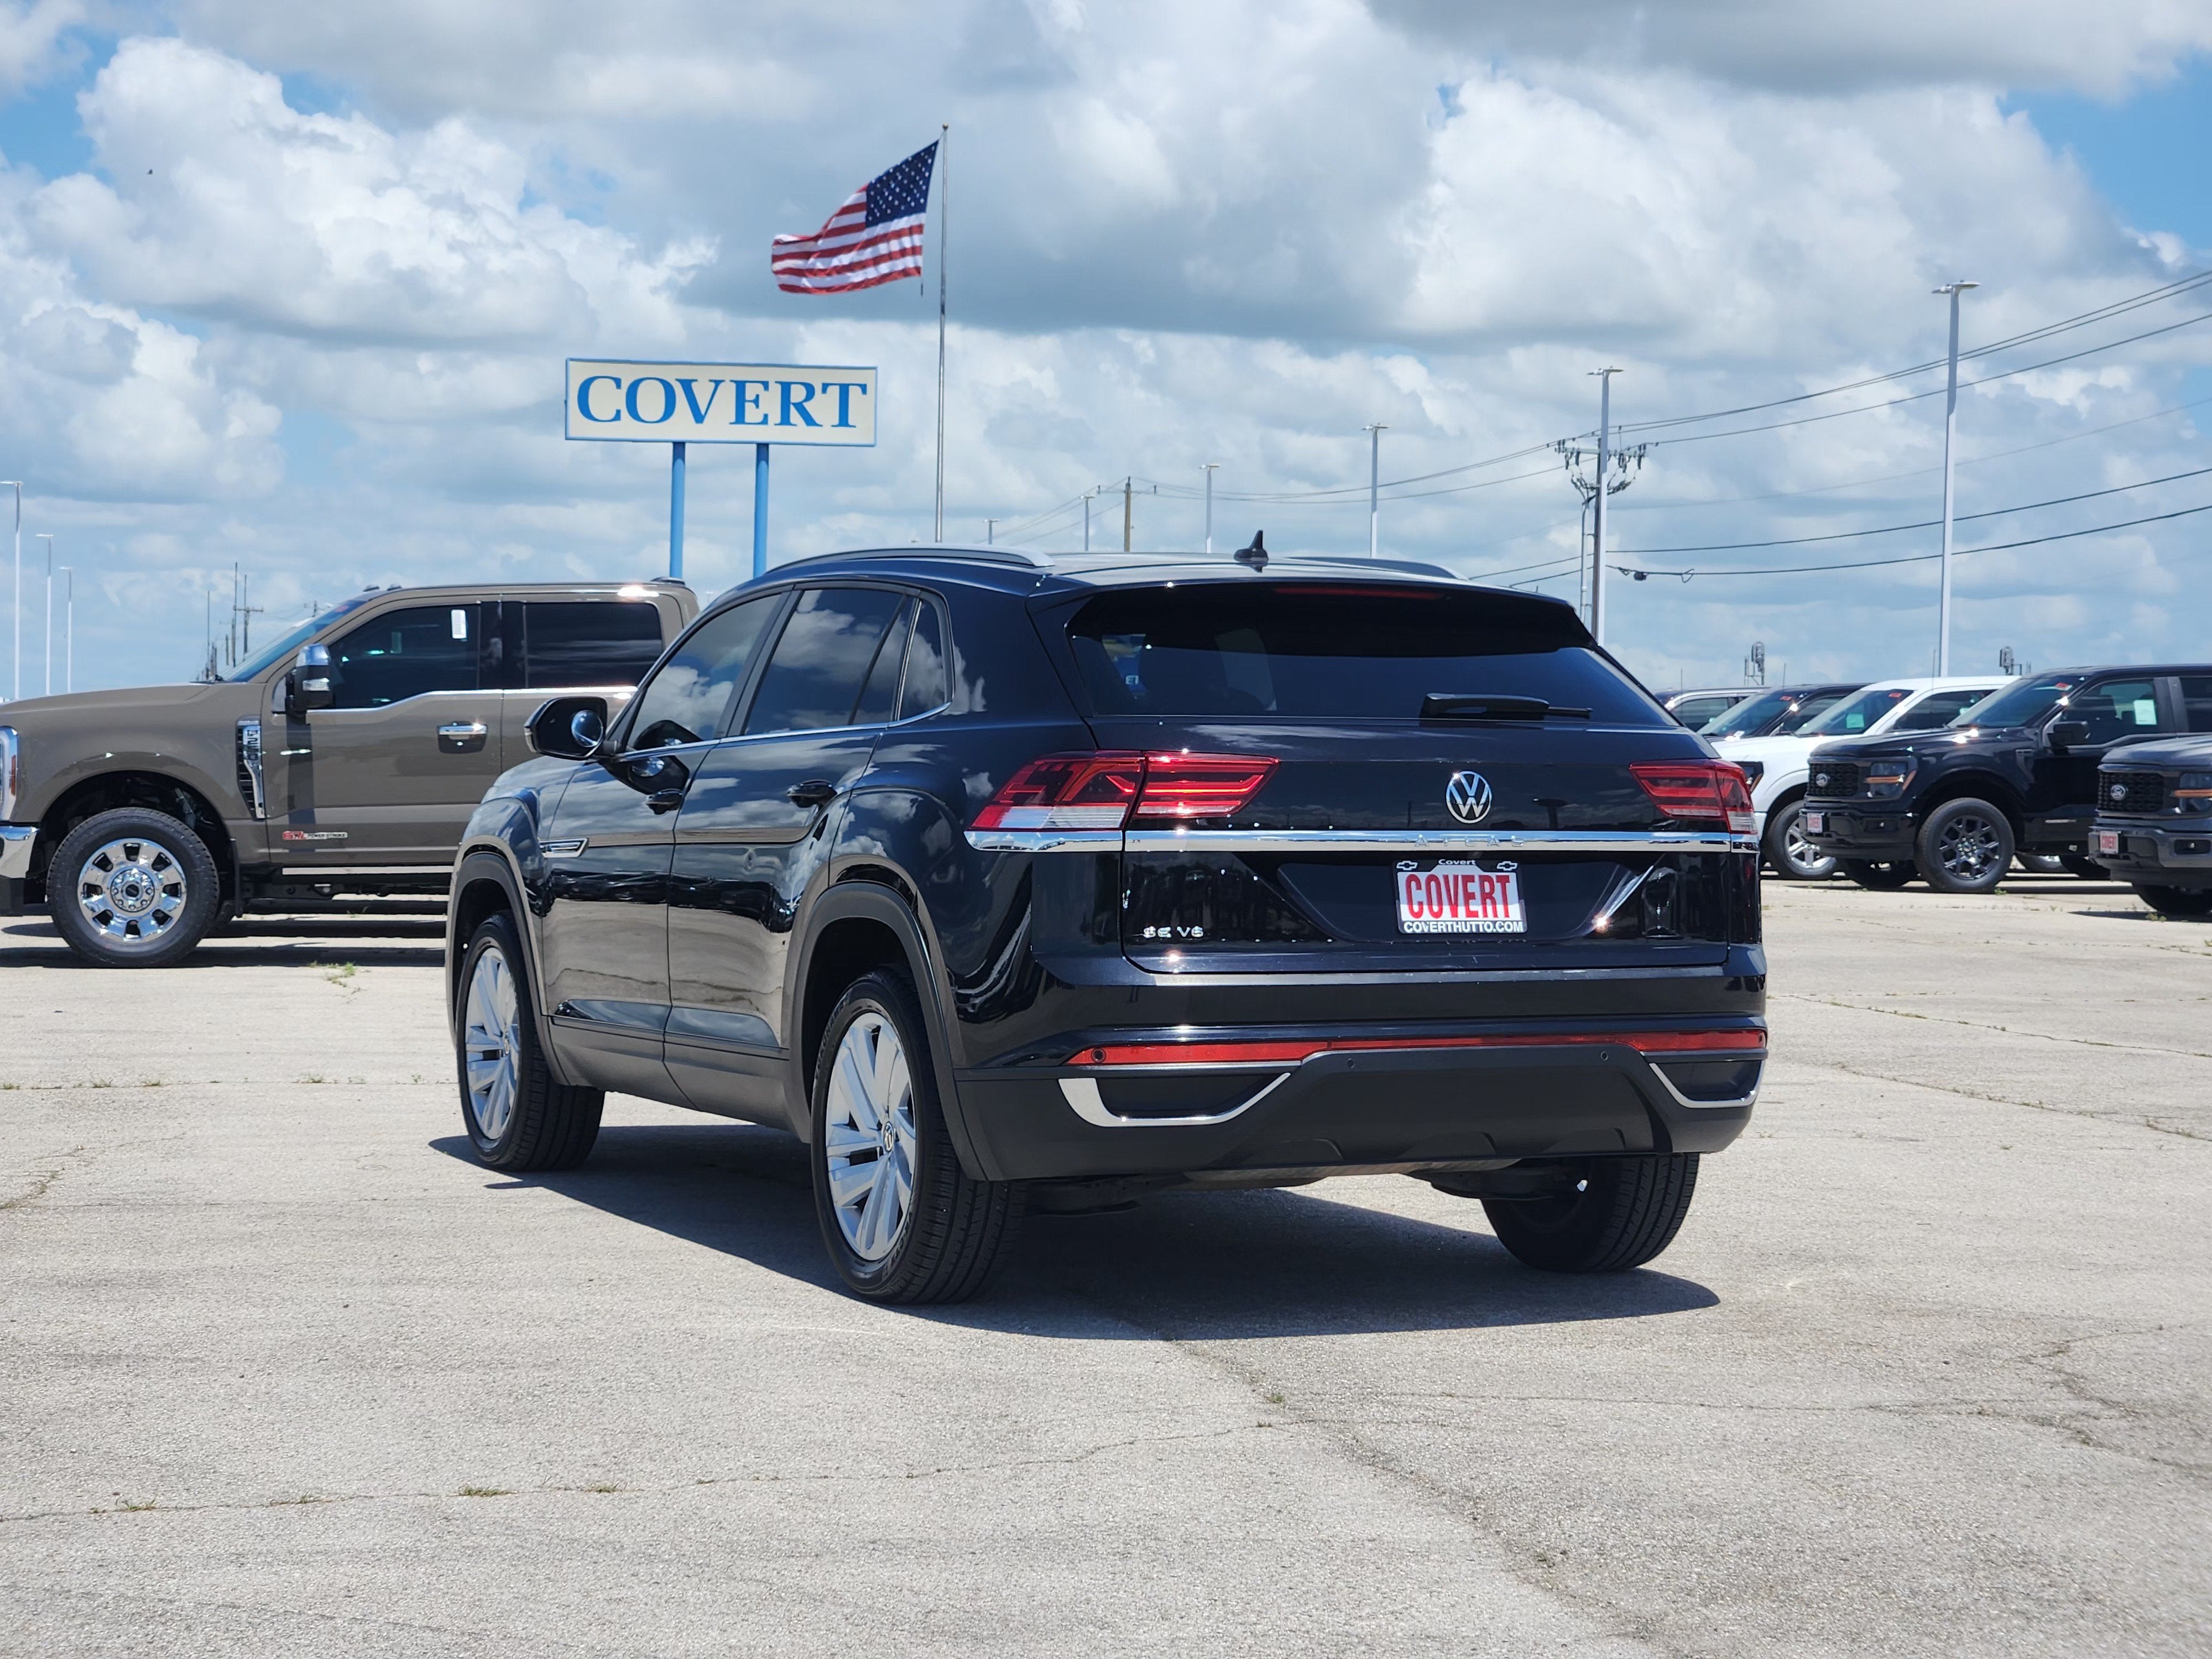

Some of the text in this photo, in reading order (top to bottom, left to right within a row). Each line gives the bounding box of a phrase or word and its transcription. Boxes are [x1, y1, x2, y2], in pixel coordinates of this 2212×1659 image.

[577, 375, 868, 428] COVERT
[1447, 773, 1491, 820] VW
[1405, 874, 1510, 919] COVERT
[1143, 926, 1204, 938] SE V6
[1404, 921, 1524, 933] COVERTHUTTO.COM
